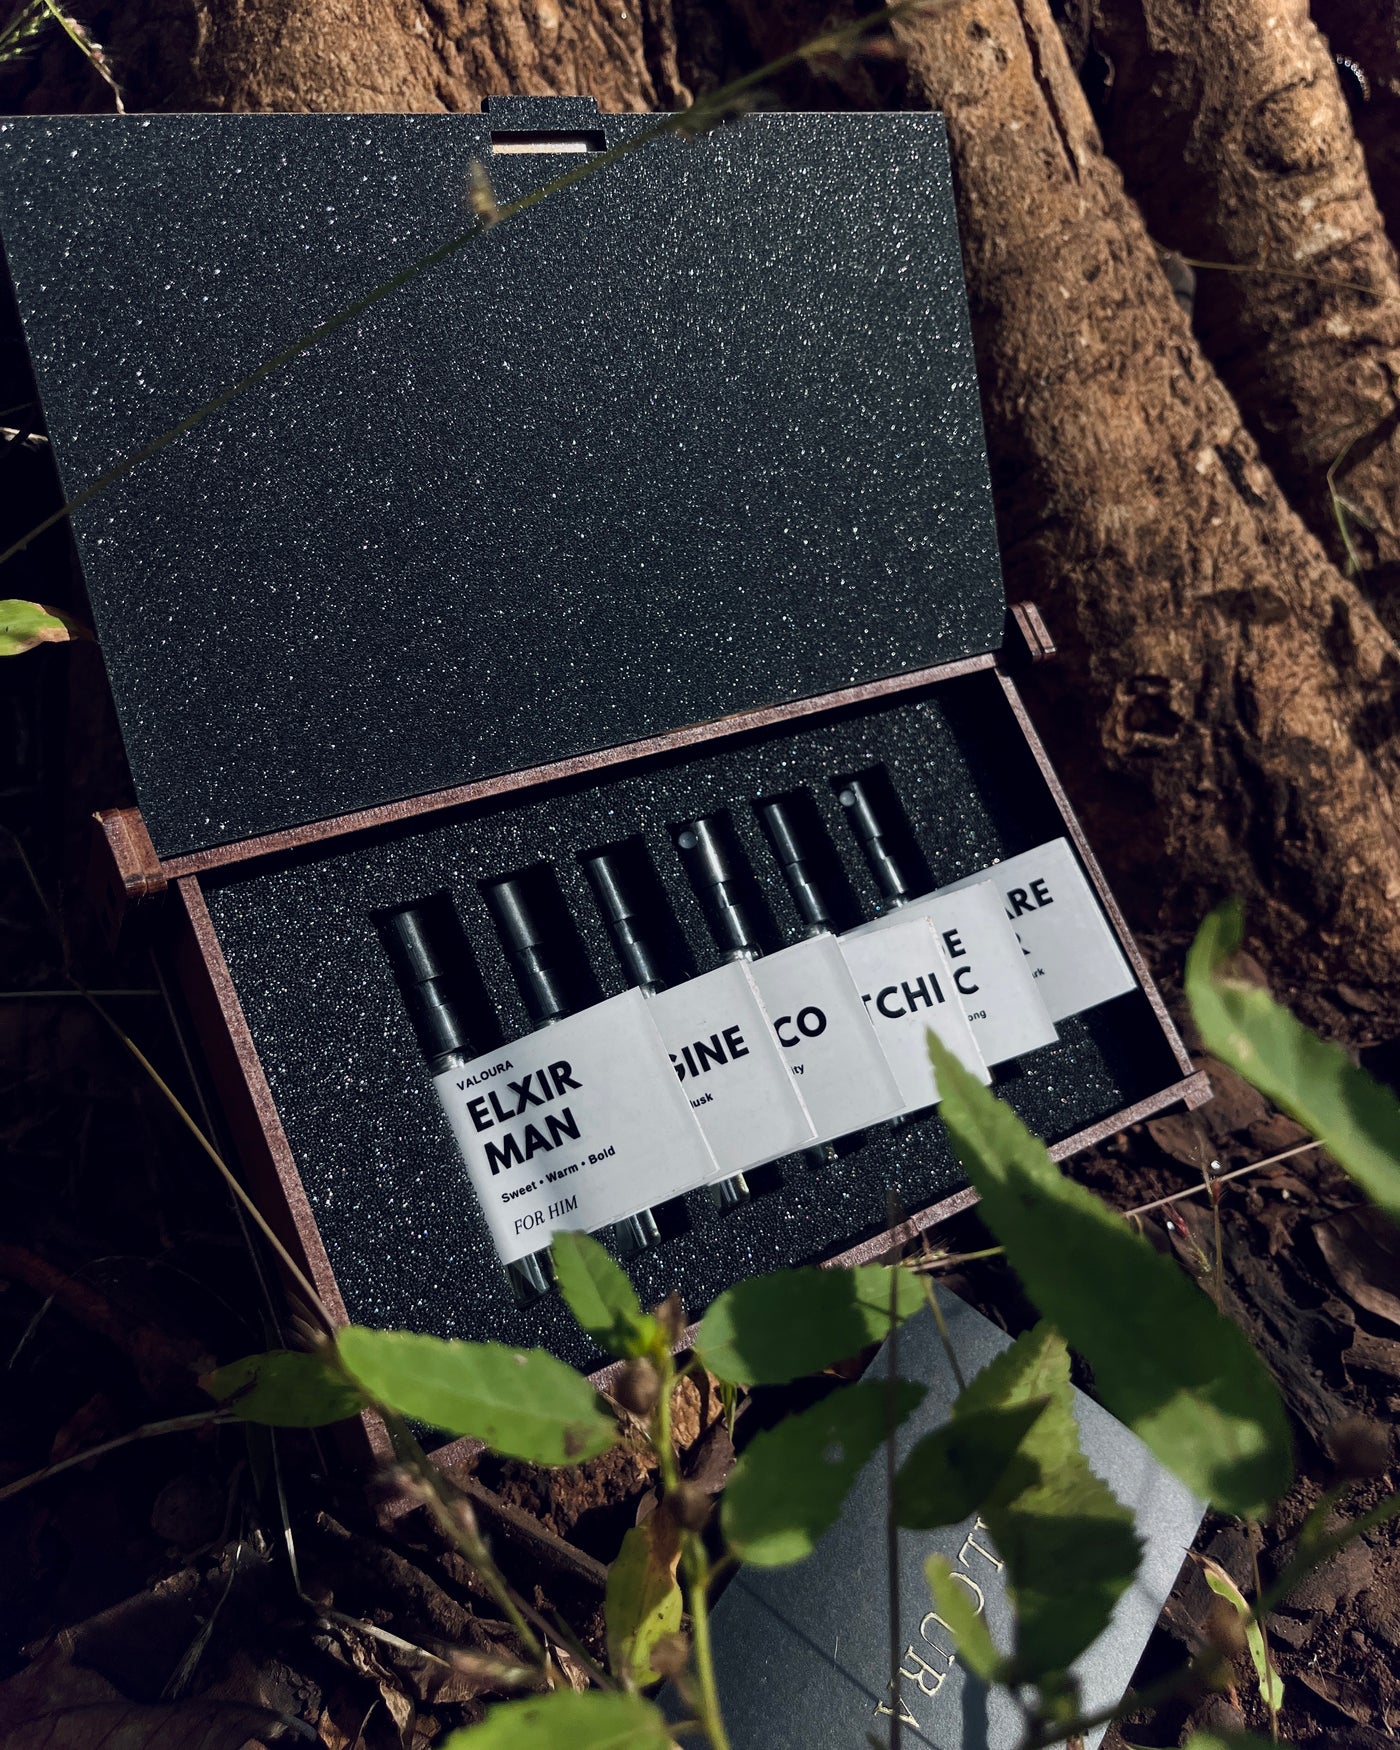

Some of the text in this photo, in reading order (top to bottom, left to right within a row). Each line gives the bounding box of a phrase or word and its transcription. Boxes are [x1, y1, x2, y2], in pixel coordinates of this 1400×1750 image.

[1004, 877, 1054, 921] RE
[457, 1060, 514, 1091] VALOURA
[466, 1059, 583, 1133] ELXIR
[690, 1092, 714, 1110] usk
[484, 1106, 581, 1176] MAN
[501, 1145, 616, 1204] Sweet Warm Bold
[513, 1194, 579, 1236] FOR HIM
